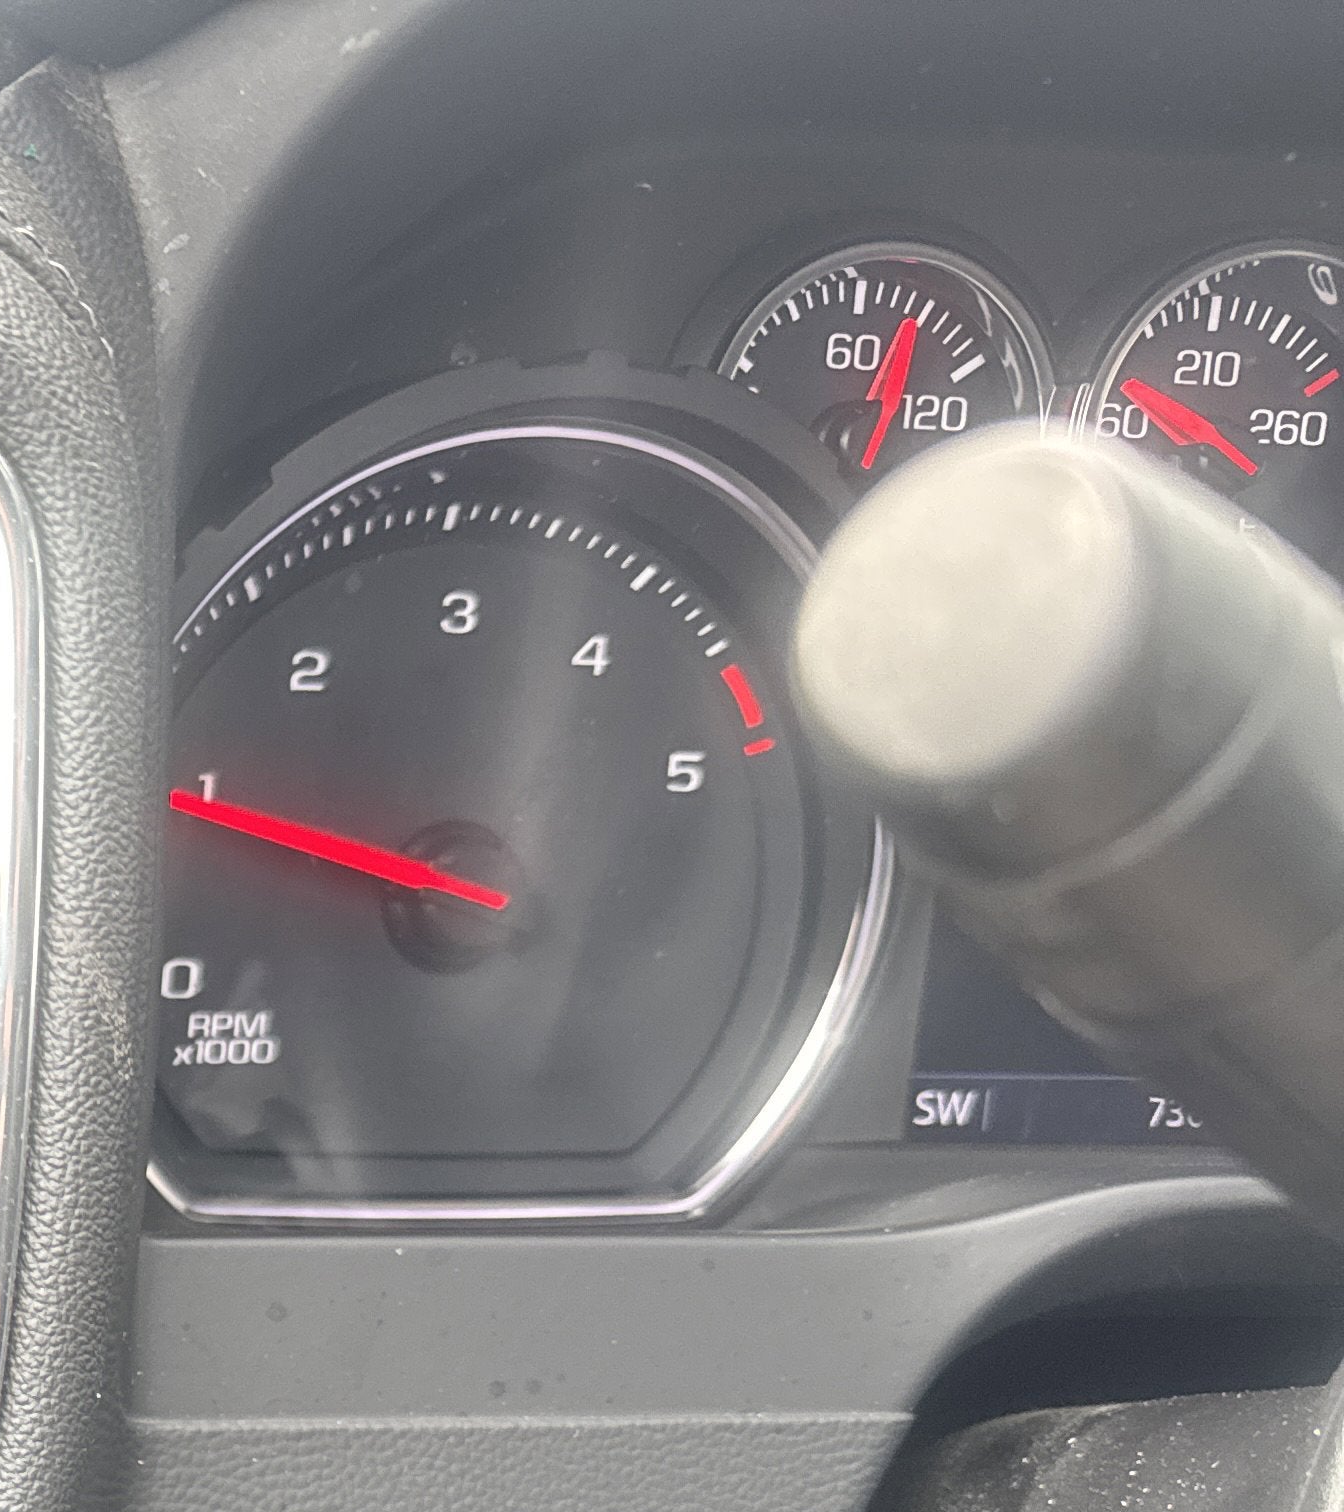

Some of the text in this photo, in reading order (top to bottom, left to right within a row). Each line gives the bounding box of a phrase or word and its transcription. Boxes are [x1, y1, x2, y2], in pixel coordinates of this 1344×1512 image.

[825, 332, 881, 371] 60
[1173, 349, 1242, 387] 210
[902, 394, 968, 431] 120
[1249, 408, 1328, 446] 260
[439, 591, 480, 634] 3
[288, 649, 331, 692] 2
[570, 633, 612, 676] 4
[198, 772, 216, 804] 1
[665, 750, 706, 793] 5
[160, 957, 204, 999] 0
[187, 1010, 272, 1038] RPM
[172, 1038, 280, 1067] x1000
[912, 1088, 979, 1126] SW
